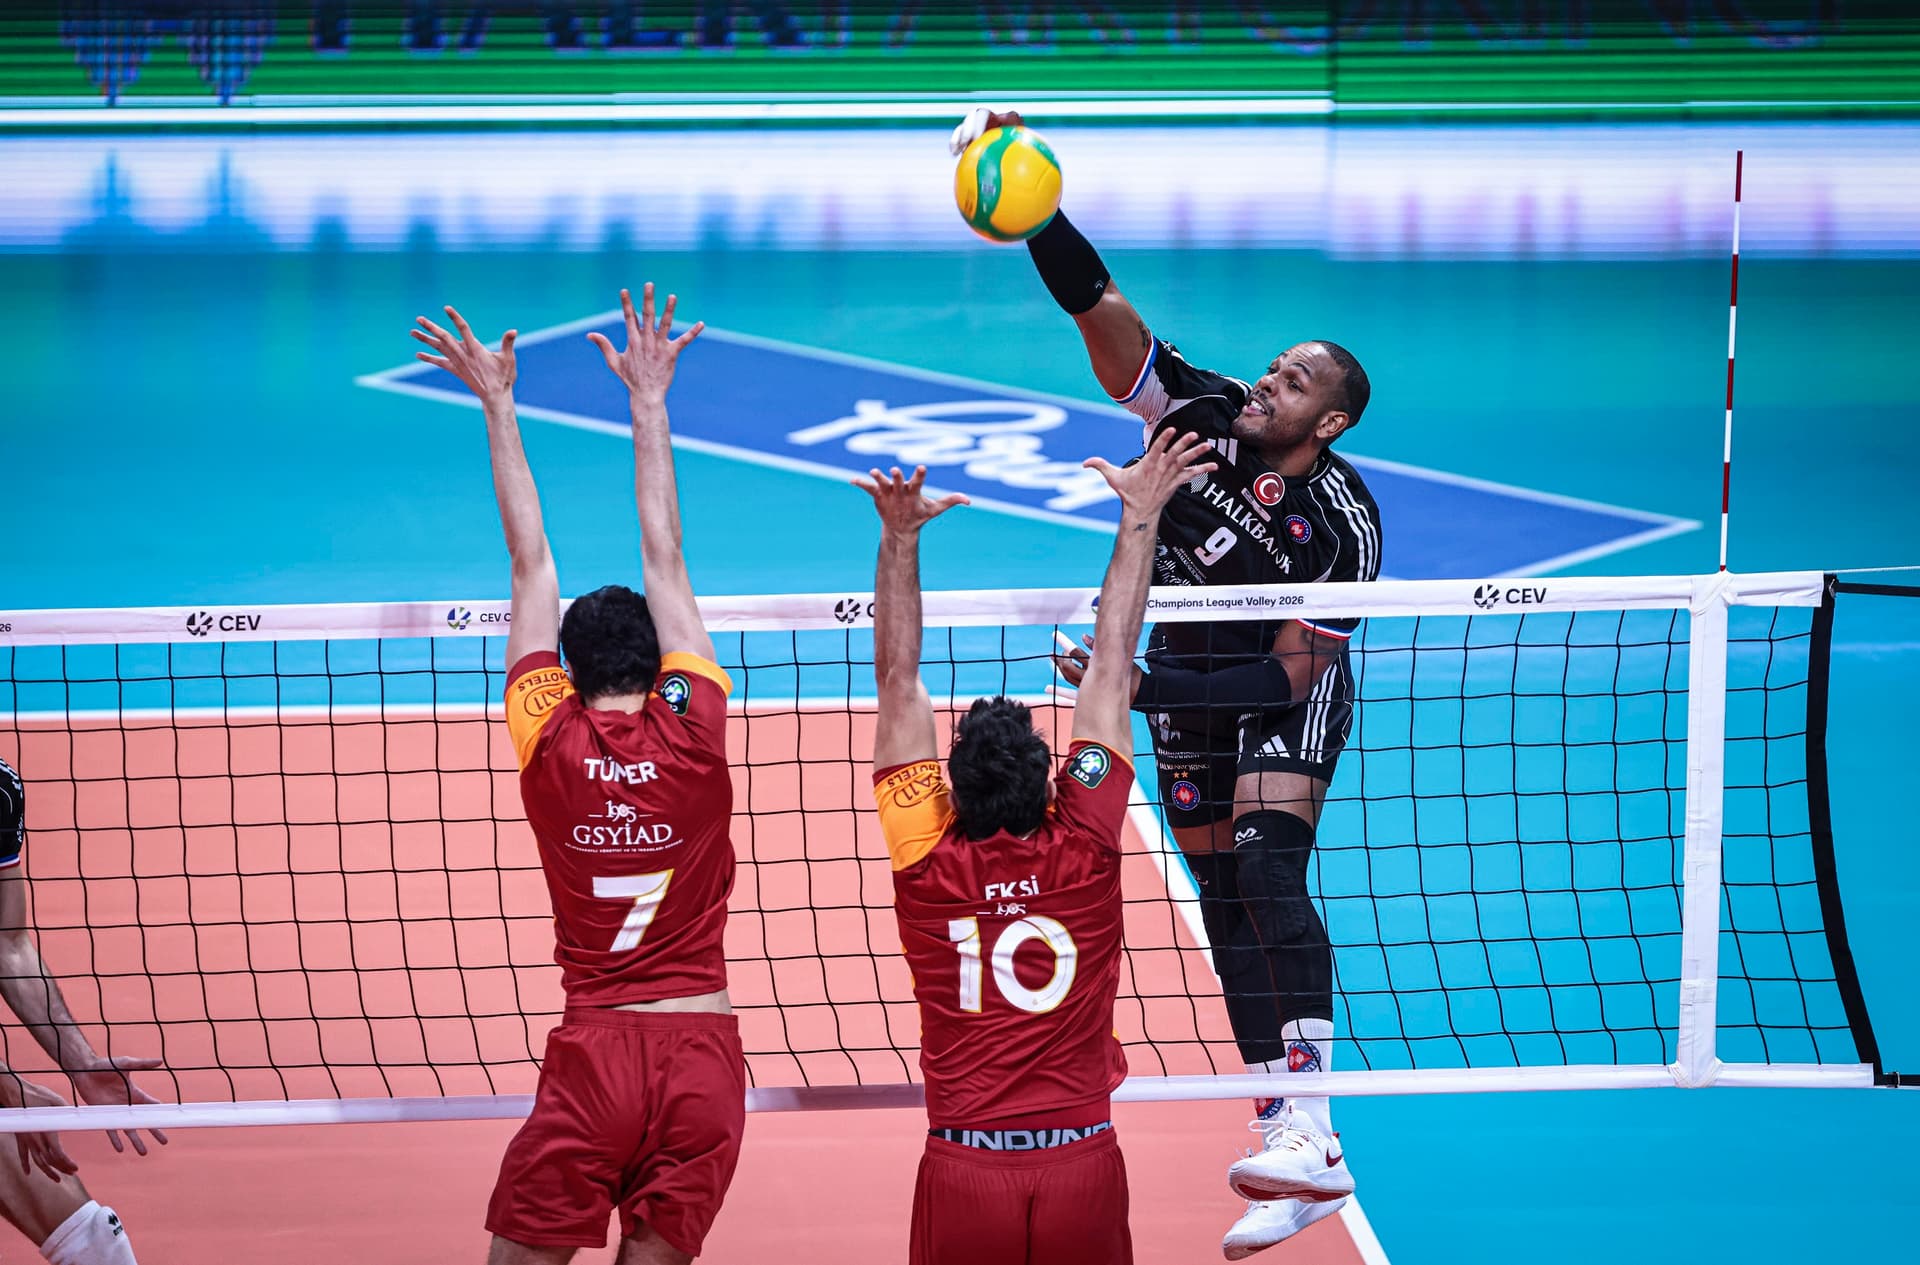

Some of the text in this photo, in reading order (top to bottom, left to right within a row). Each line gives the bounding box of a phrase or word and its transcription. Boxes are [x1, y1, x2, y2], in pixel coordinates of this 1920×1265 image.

[1203, 482, 1296, 575] HALKBANK
[1194, 526, 1238, 567] 9
[1147, 595, 1304, 609] Champions League Volley 2026
[1505, 587, 1548, 605] CEV
[219, 615, 261, 631] CEV
[480, 613, 501, 623] CEV
[605, 800, 637, 823] 1905
[573, 823, 673, 846] GSYİAD
[592, 868, 675, 953] 7
[948, 915, 1078, 1014] 10
